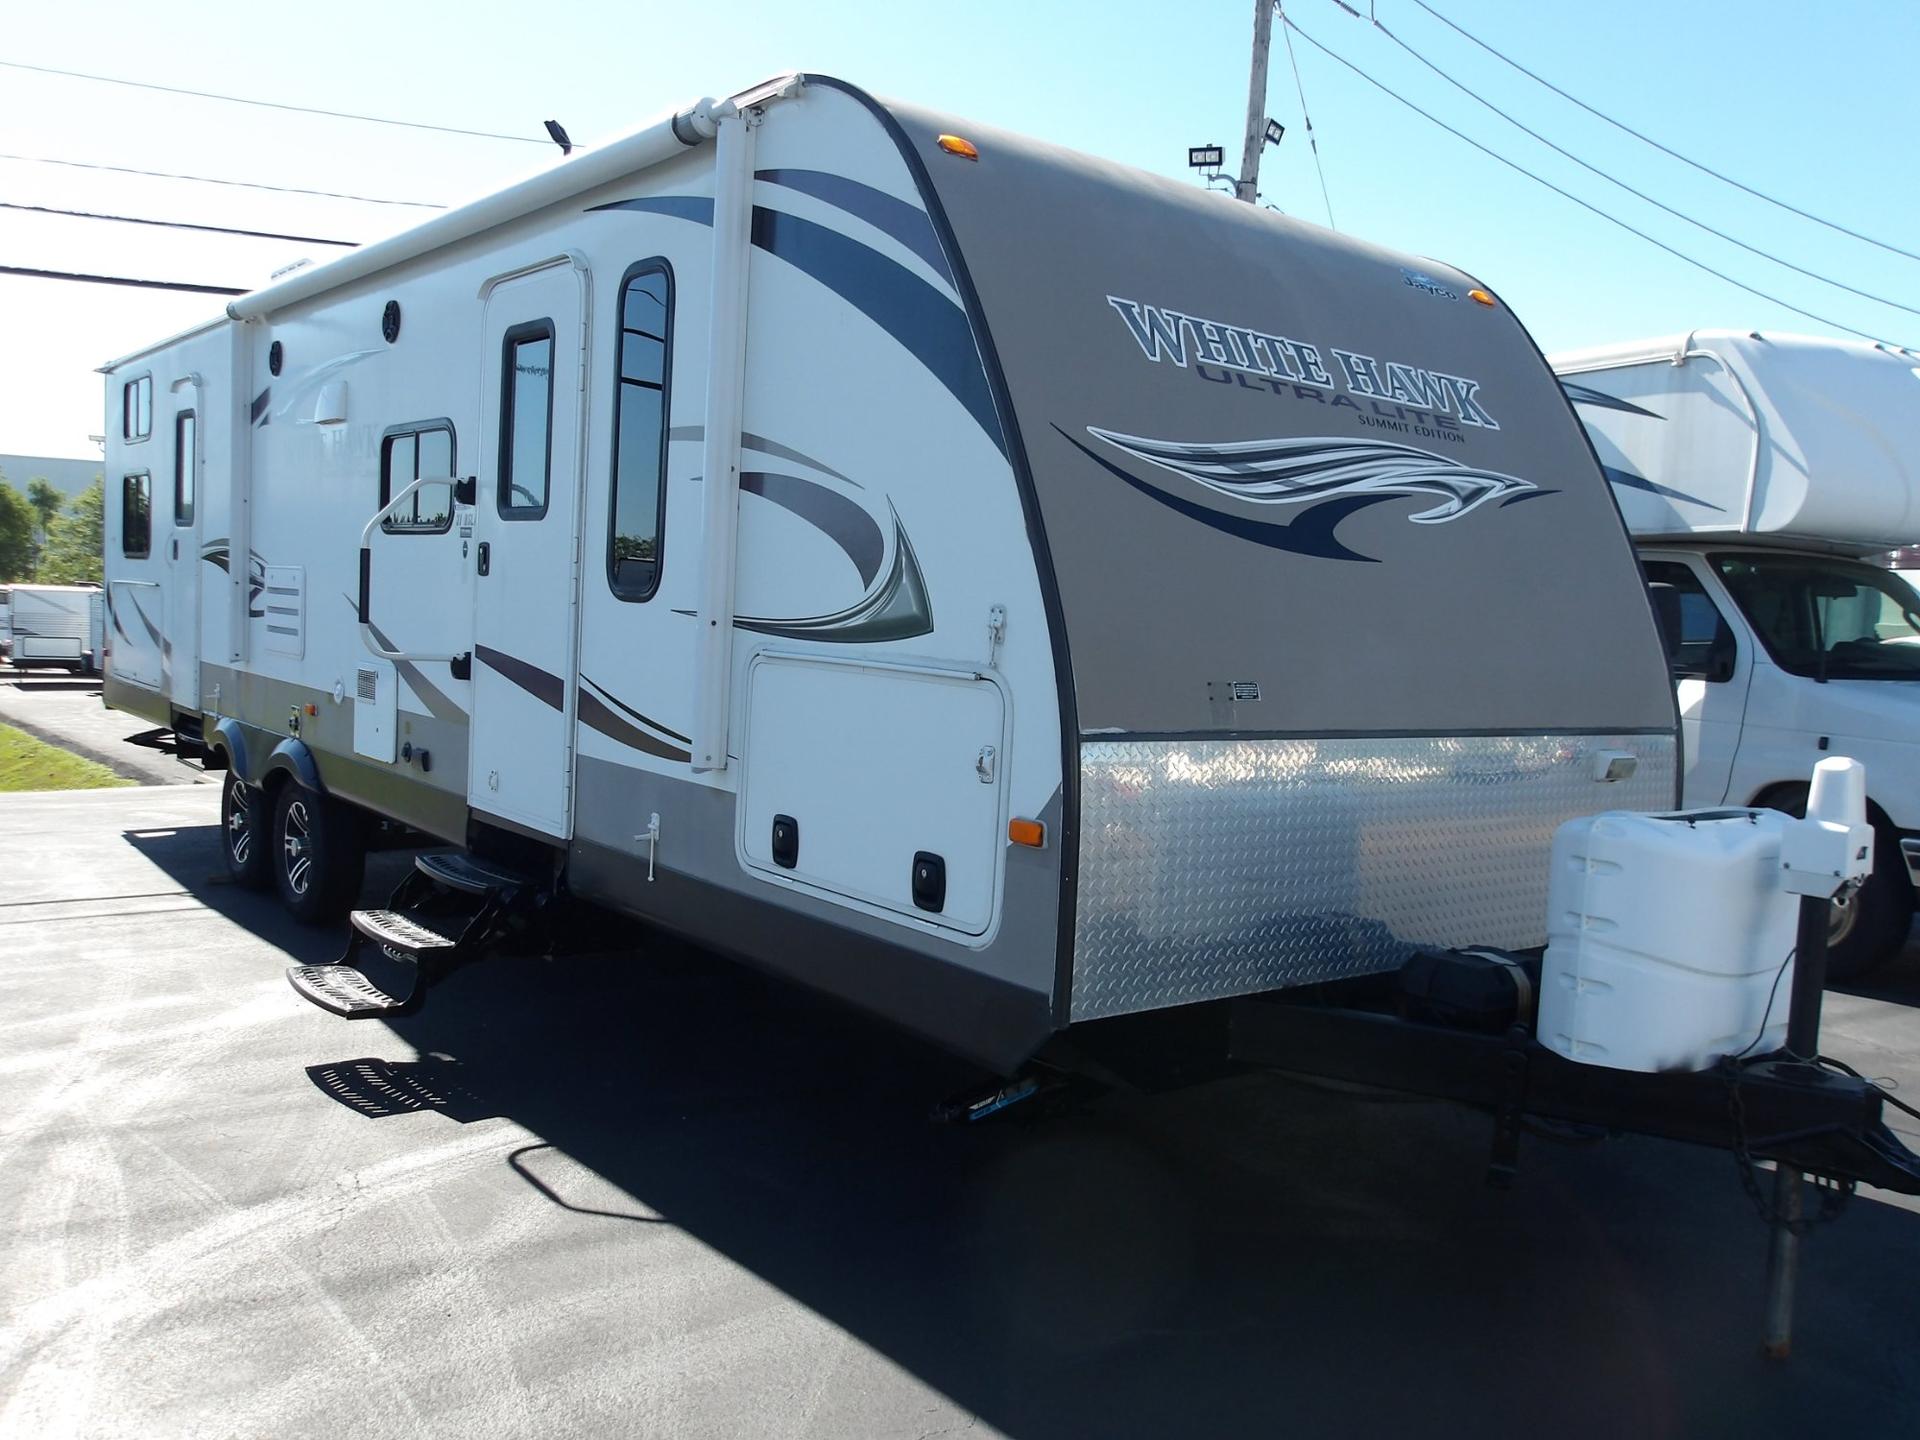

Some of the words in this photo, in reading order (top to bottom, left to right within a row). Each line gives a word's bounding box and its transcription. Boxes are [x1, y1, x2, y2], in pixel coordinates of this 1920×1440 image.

[1404, 277, 1458, 300] Jayco
[1106, 295, 1333, 389] WHITE
[1331, 347, 1500, 431] HAWK
[1196, 364, 1362, 412] ULTRA
[1370, 400, 1460, 431] LITE
[1358, 414, 1410, 434] SUMMIT
[1414, 425, 1466, 443] EDITION
